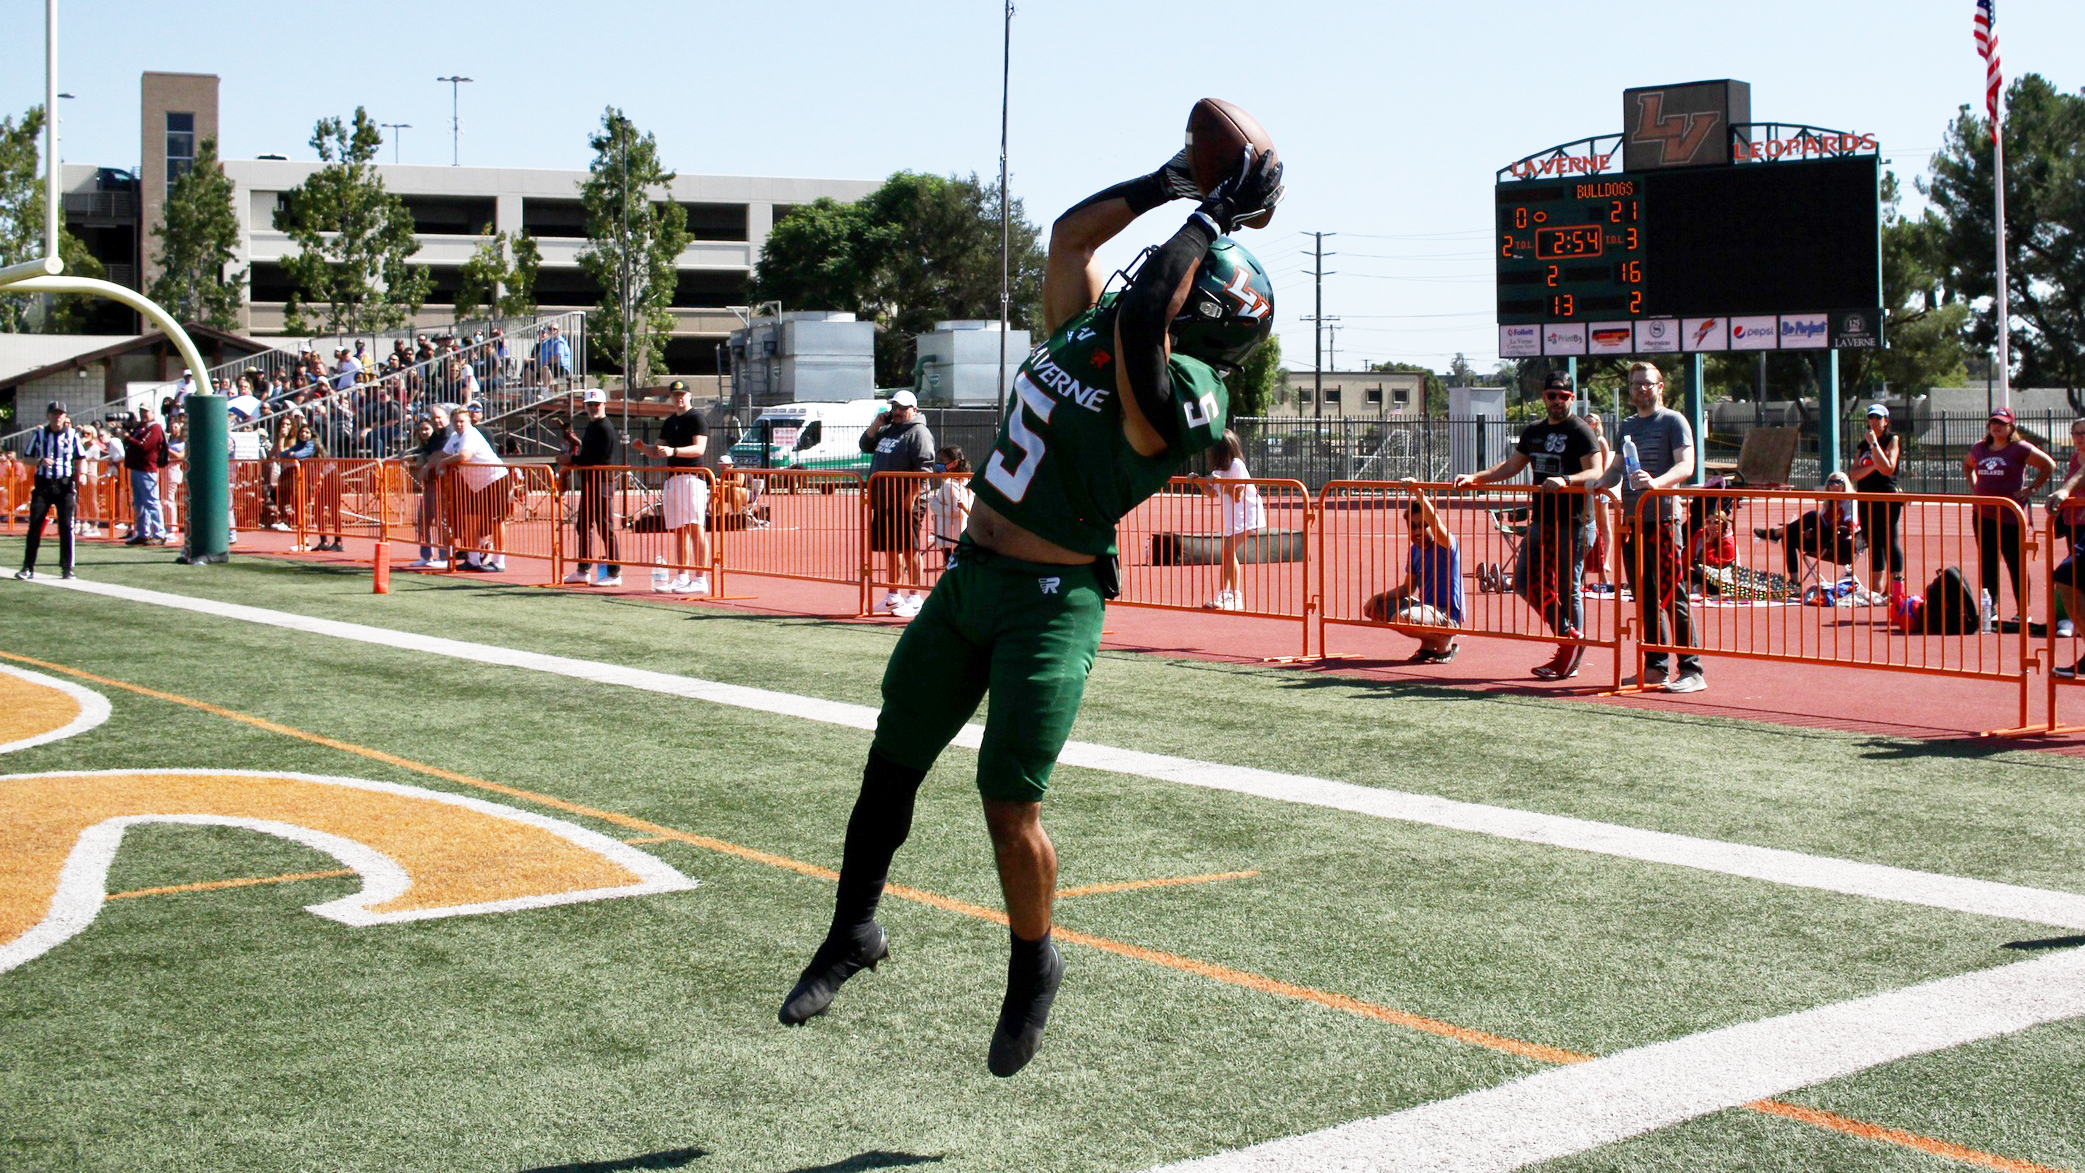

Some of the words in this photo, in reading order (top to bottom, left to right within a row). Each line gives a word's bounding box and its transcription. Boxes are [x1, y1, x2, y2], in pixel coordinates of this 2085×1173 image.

[1631, 91, 1721, 166] LV
[1734, 133, 1877, 159] LEOPARDS
[1577, 182, 1633, 198] BULLDOGS
[1610, 201, 1637, 222] 21
[1502, 235, 1513, 256] 2
[1553, 231, 1598, 254] 2:54
[1627, 228, 1638, 249] 3
[1547, 265, 1558, 286] 2
[1622, 261, 1641, 282] 16
[1554, 294, 1573, 316] 13
[1630, 291, 1642, 313] 2
[1747, 326, 1774, 337] pepsi
[1184, 390, 1220, 429] 5
[984, 370, 1057, 504] 5
[1544, 432, 1568, 453] 85
